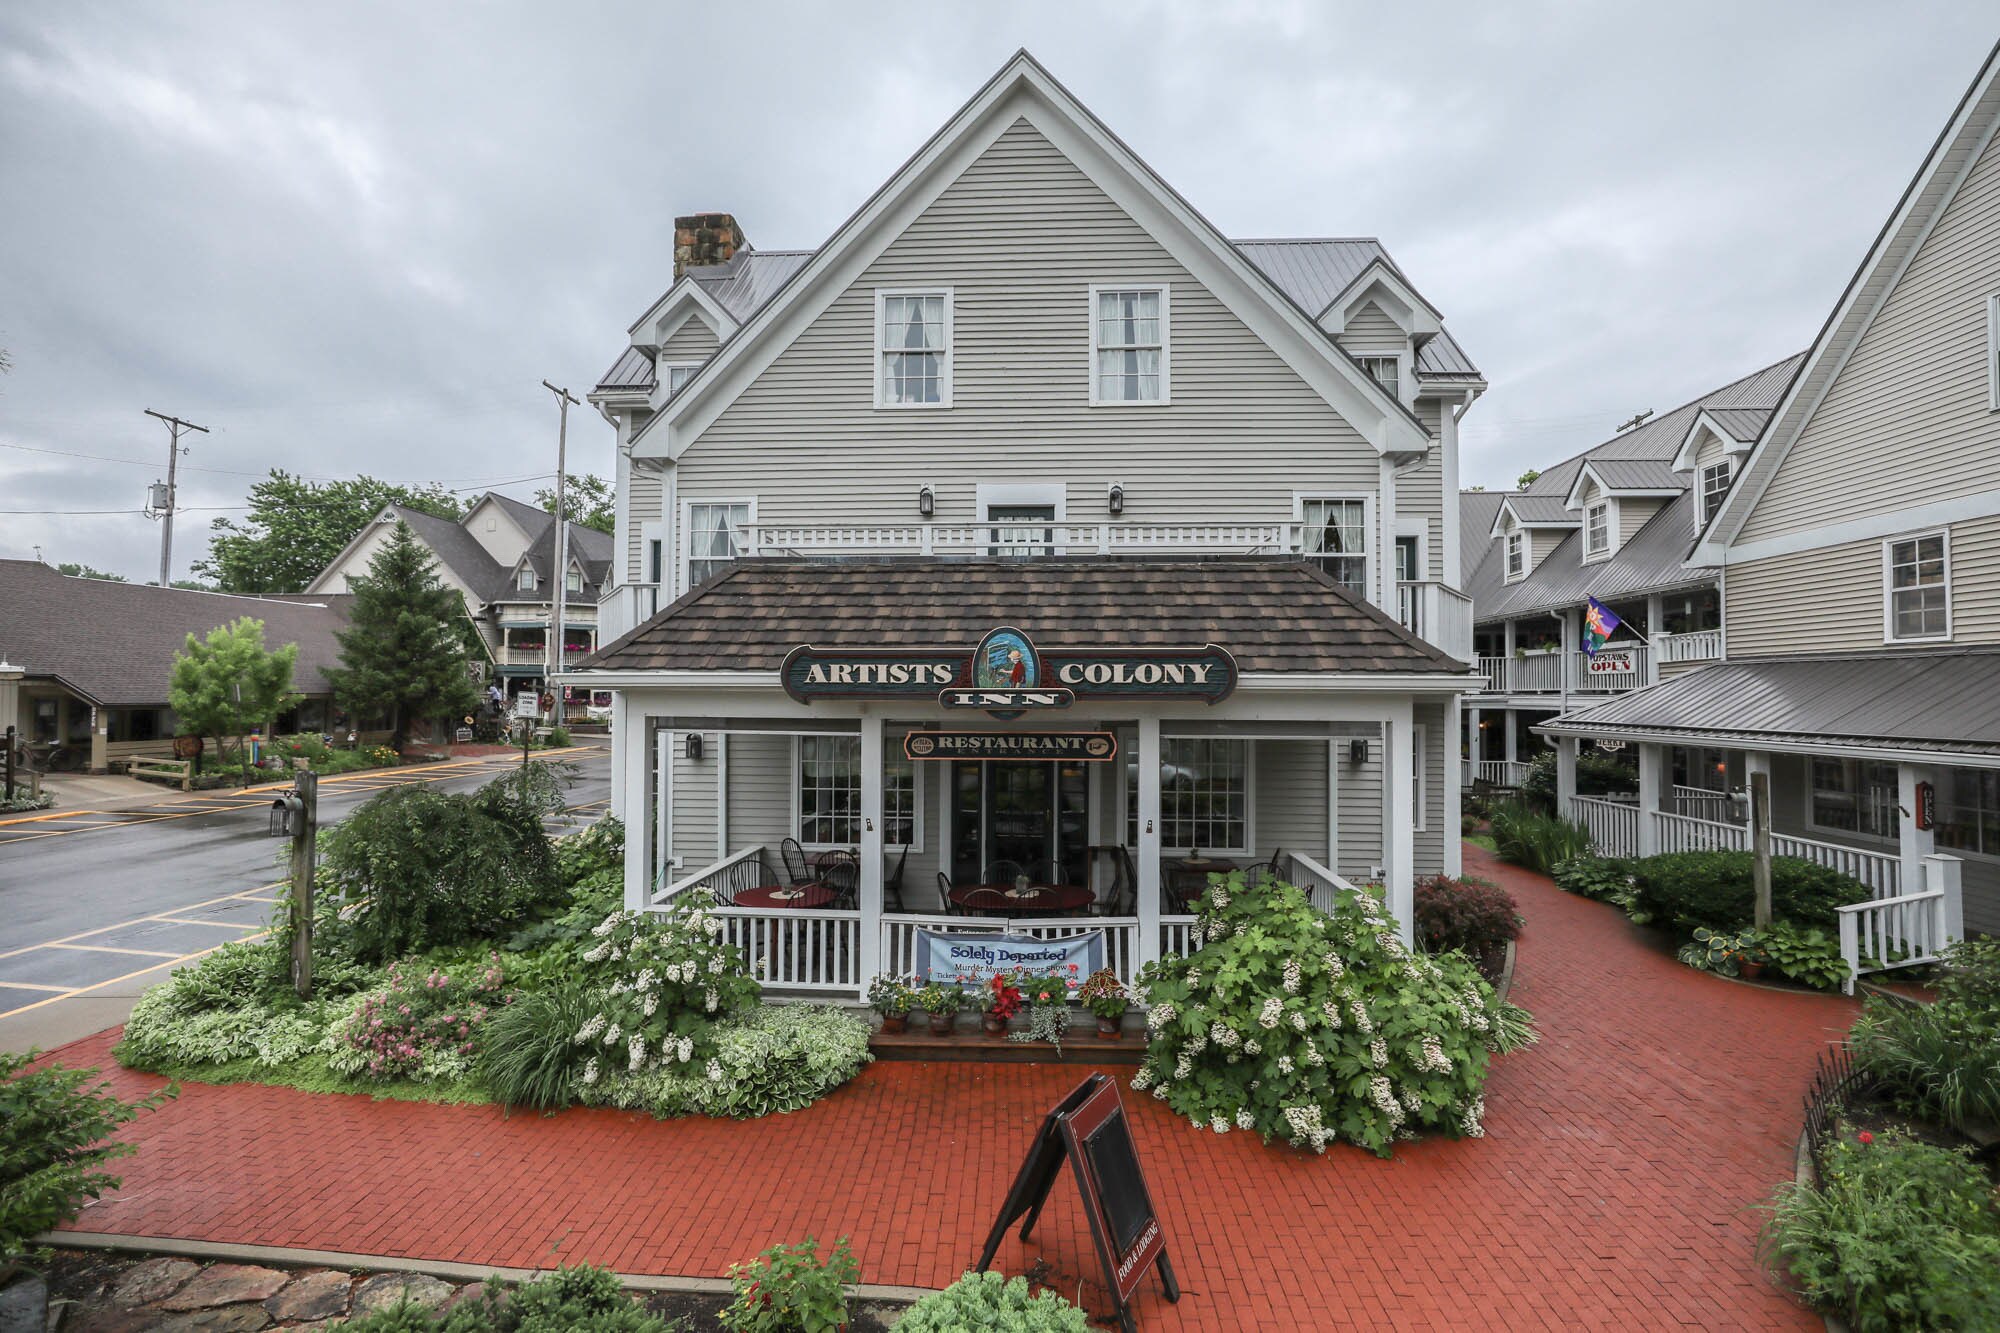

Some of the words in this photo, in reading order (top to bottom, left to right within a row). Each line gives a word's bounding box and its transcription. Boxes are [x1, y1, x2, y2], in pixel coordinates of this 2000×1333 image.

[804, 663, 953, 684] ARTISTS
[1059, 663, 1213, 684] COLONY
[1591, 661, 1630, 671] OPEN
[954, 693, 1059, 705] INN
[938, 736, 1083, 749] RESTAURANT
[1924, 790, 1932, 824] OPEN
[951, 946, 994, 965] Solely
[997, 947, 1067, 963] Departed
[955, 963, 984, 972] Murder
[985, 965, 1016, 975] Mystery
[1118, 1256, 1133, 1283] FOOD
[1132, 1250, 1138, 1263] &
[1136, 1221, 1158, 1257] LODGING
